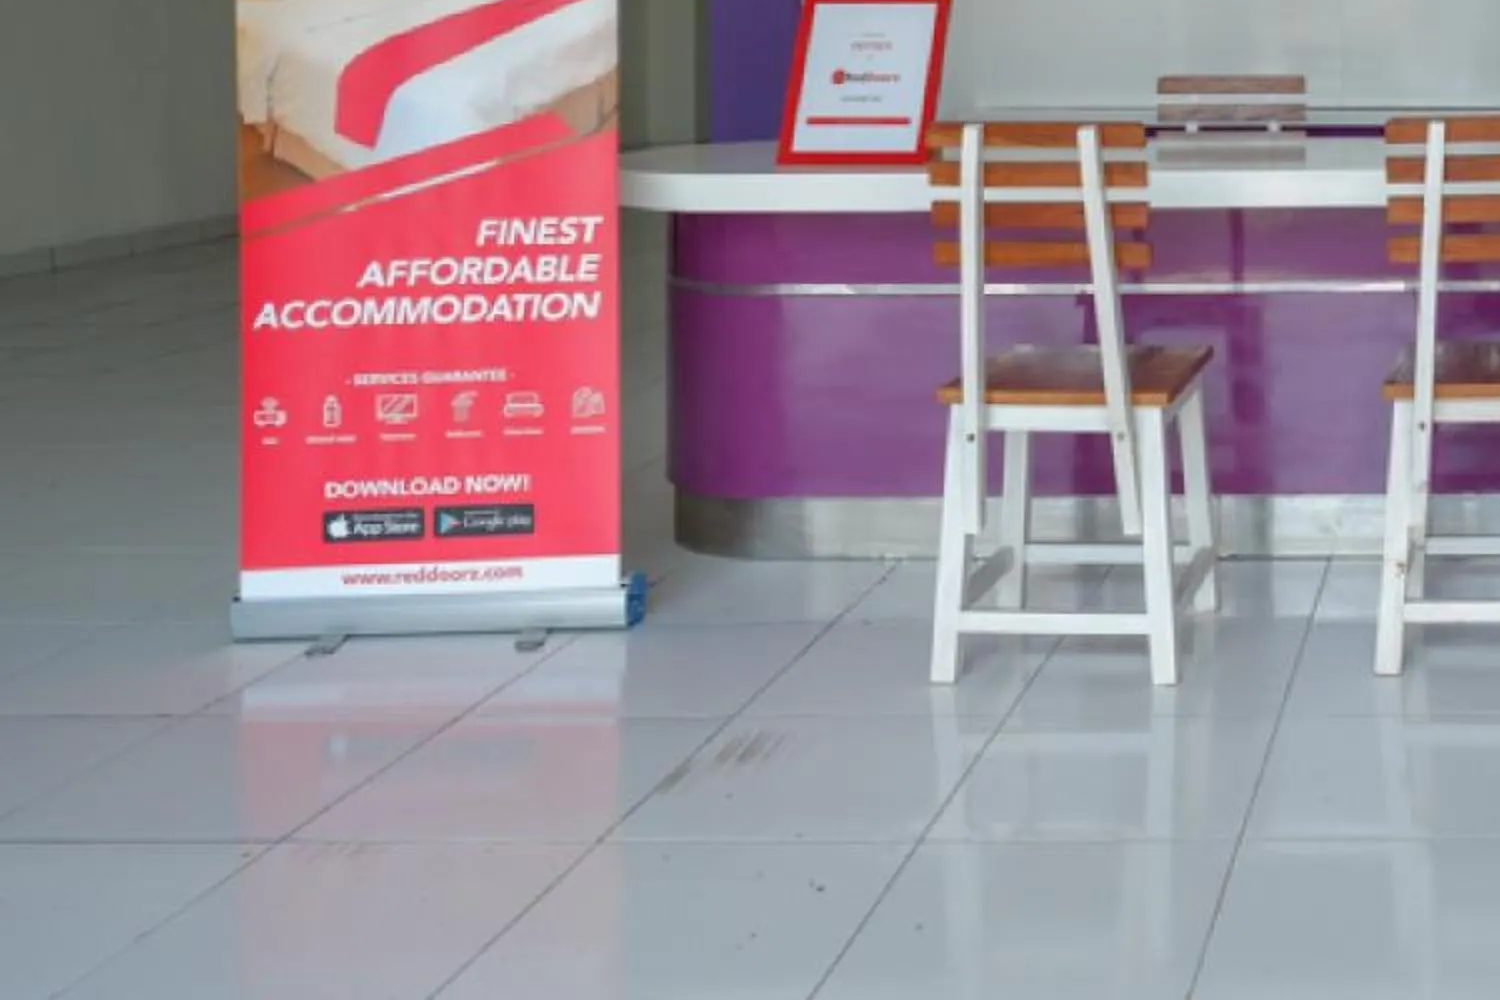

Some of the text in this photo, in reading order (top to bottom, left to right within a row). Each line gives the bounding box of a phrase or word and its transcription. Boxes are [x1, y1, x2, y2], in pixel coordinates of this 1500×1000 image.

[476, 216, 603, 247] FINEST
[356, 253, 602, 289] AFFORDABLE
[253, 291, 602, 330] ACCOMMODATION
[323, 473, 531, 499] DOWNLOAD NOW!
[353, 522, 382, 537] App
[341, 566, 524, 585] www.reddoorz.com
